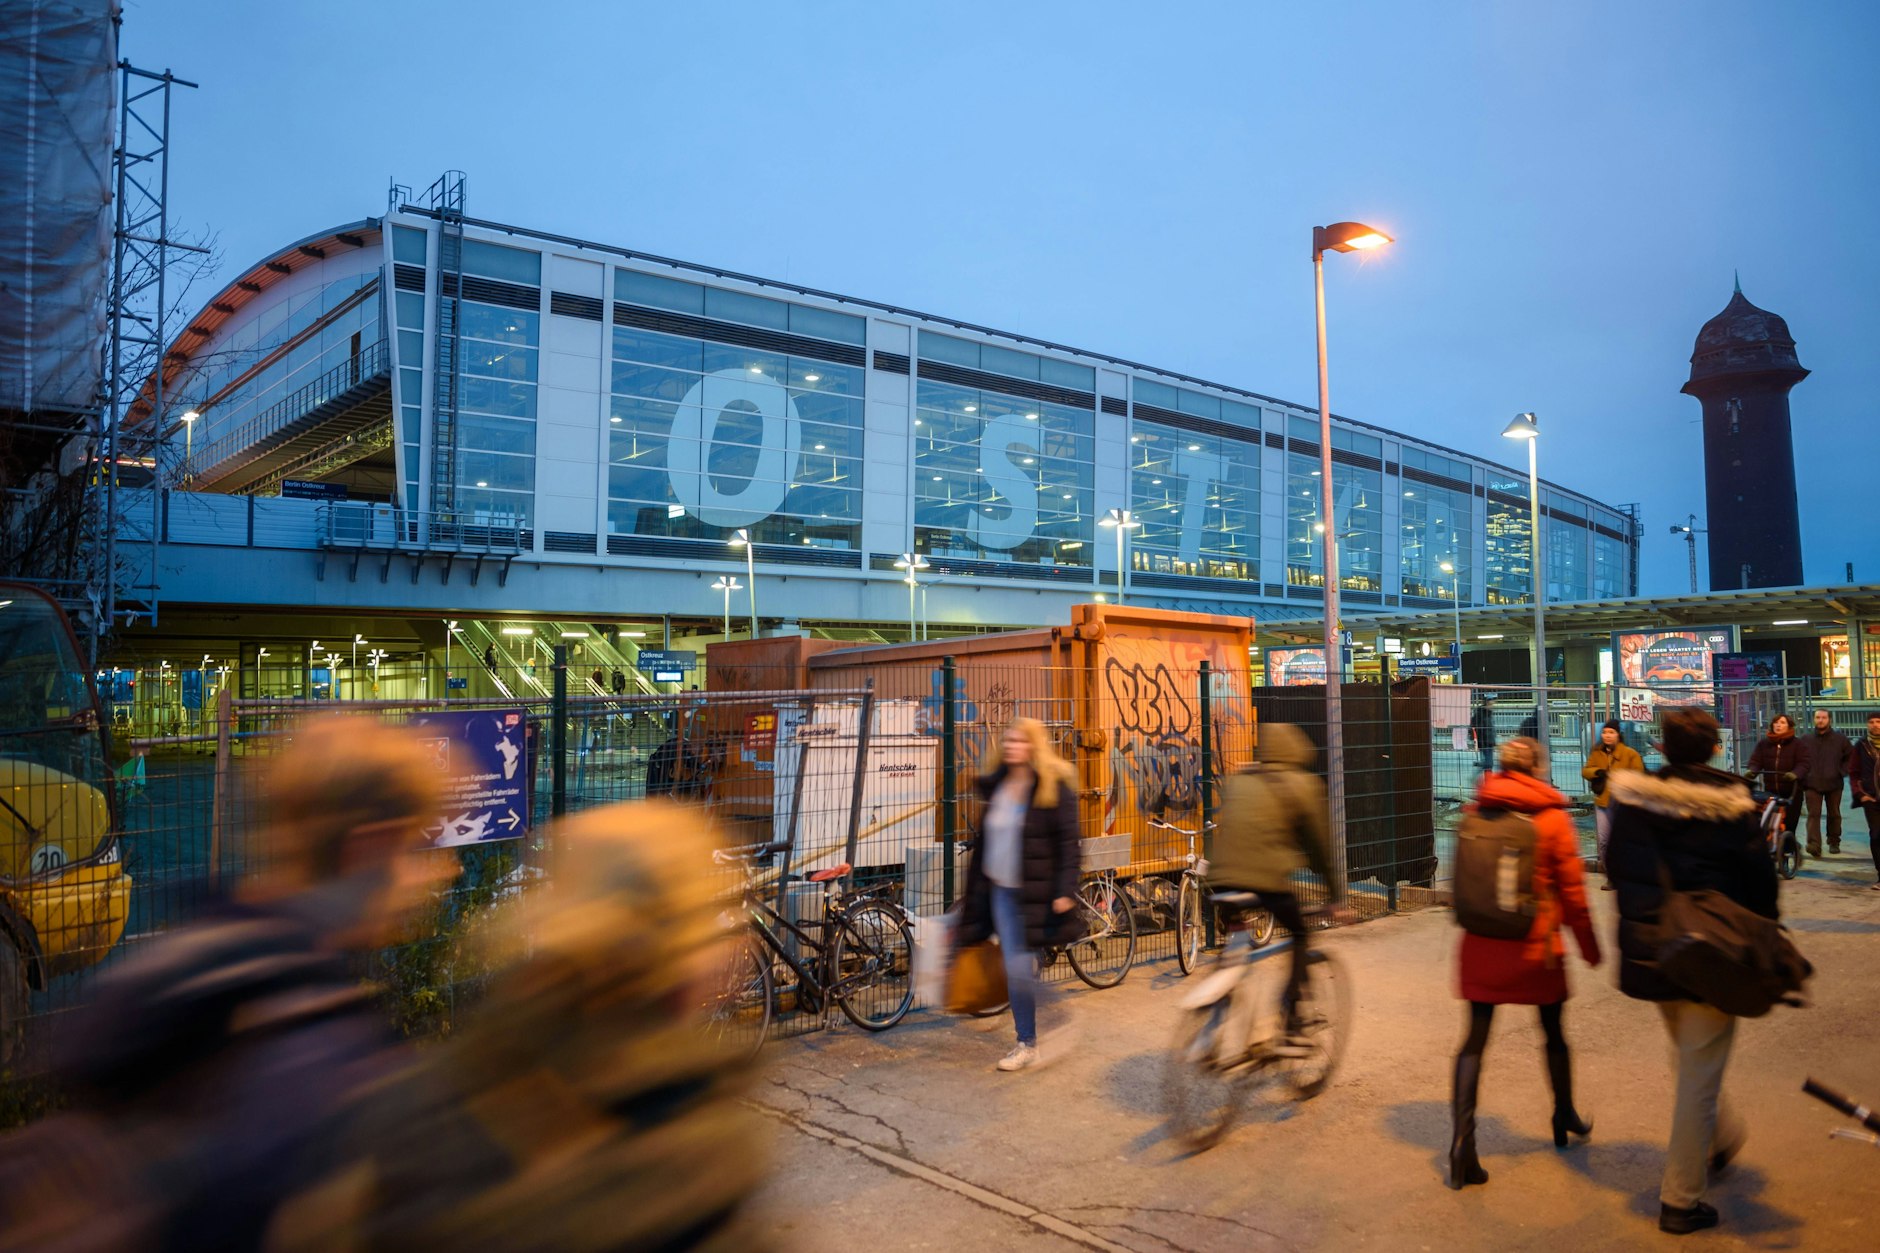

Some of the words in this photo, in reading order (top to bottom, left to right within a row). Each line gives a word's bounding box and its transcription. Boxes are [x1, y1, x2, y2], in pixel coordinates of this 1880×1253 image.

[1346, 631, 1353, 646] 8
[1451, 643, 1456, 654] 7
[879, 763, 917, 772] Hentschke
[493, 788, 519, 796] Fahrräder
[39, 852, 60, 872] 20
